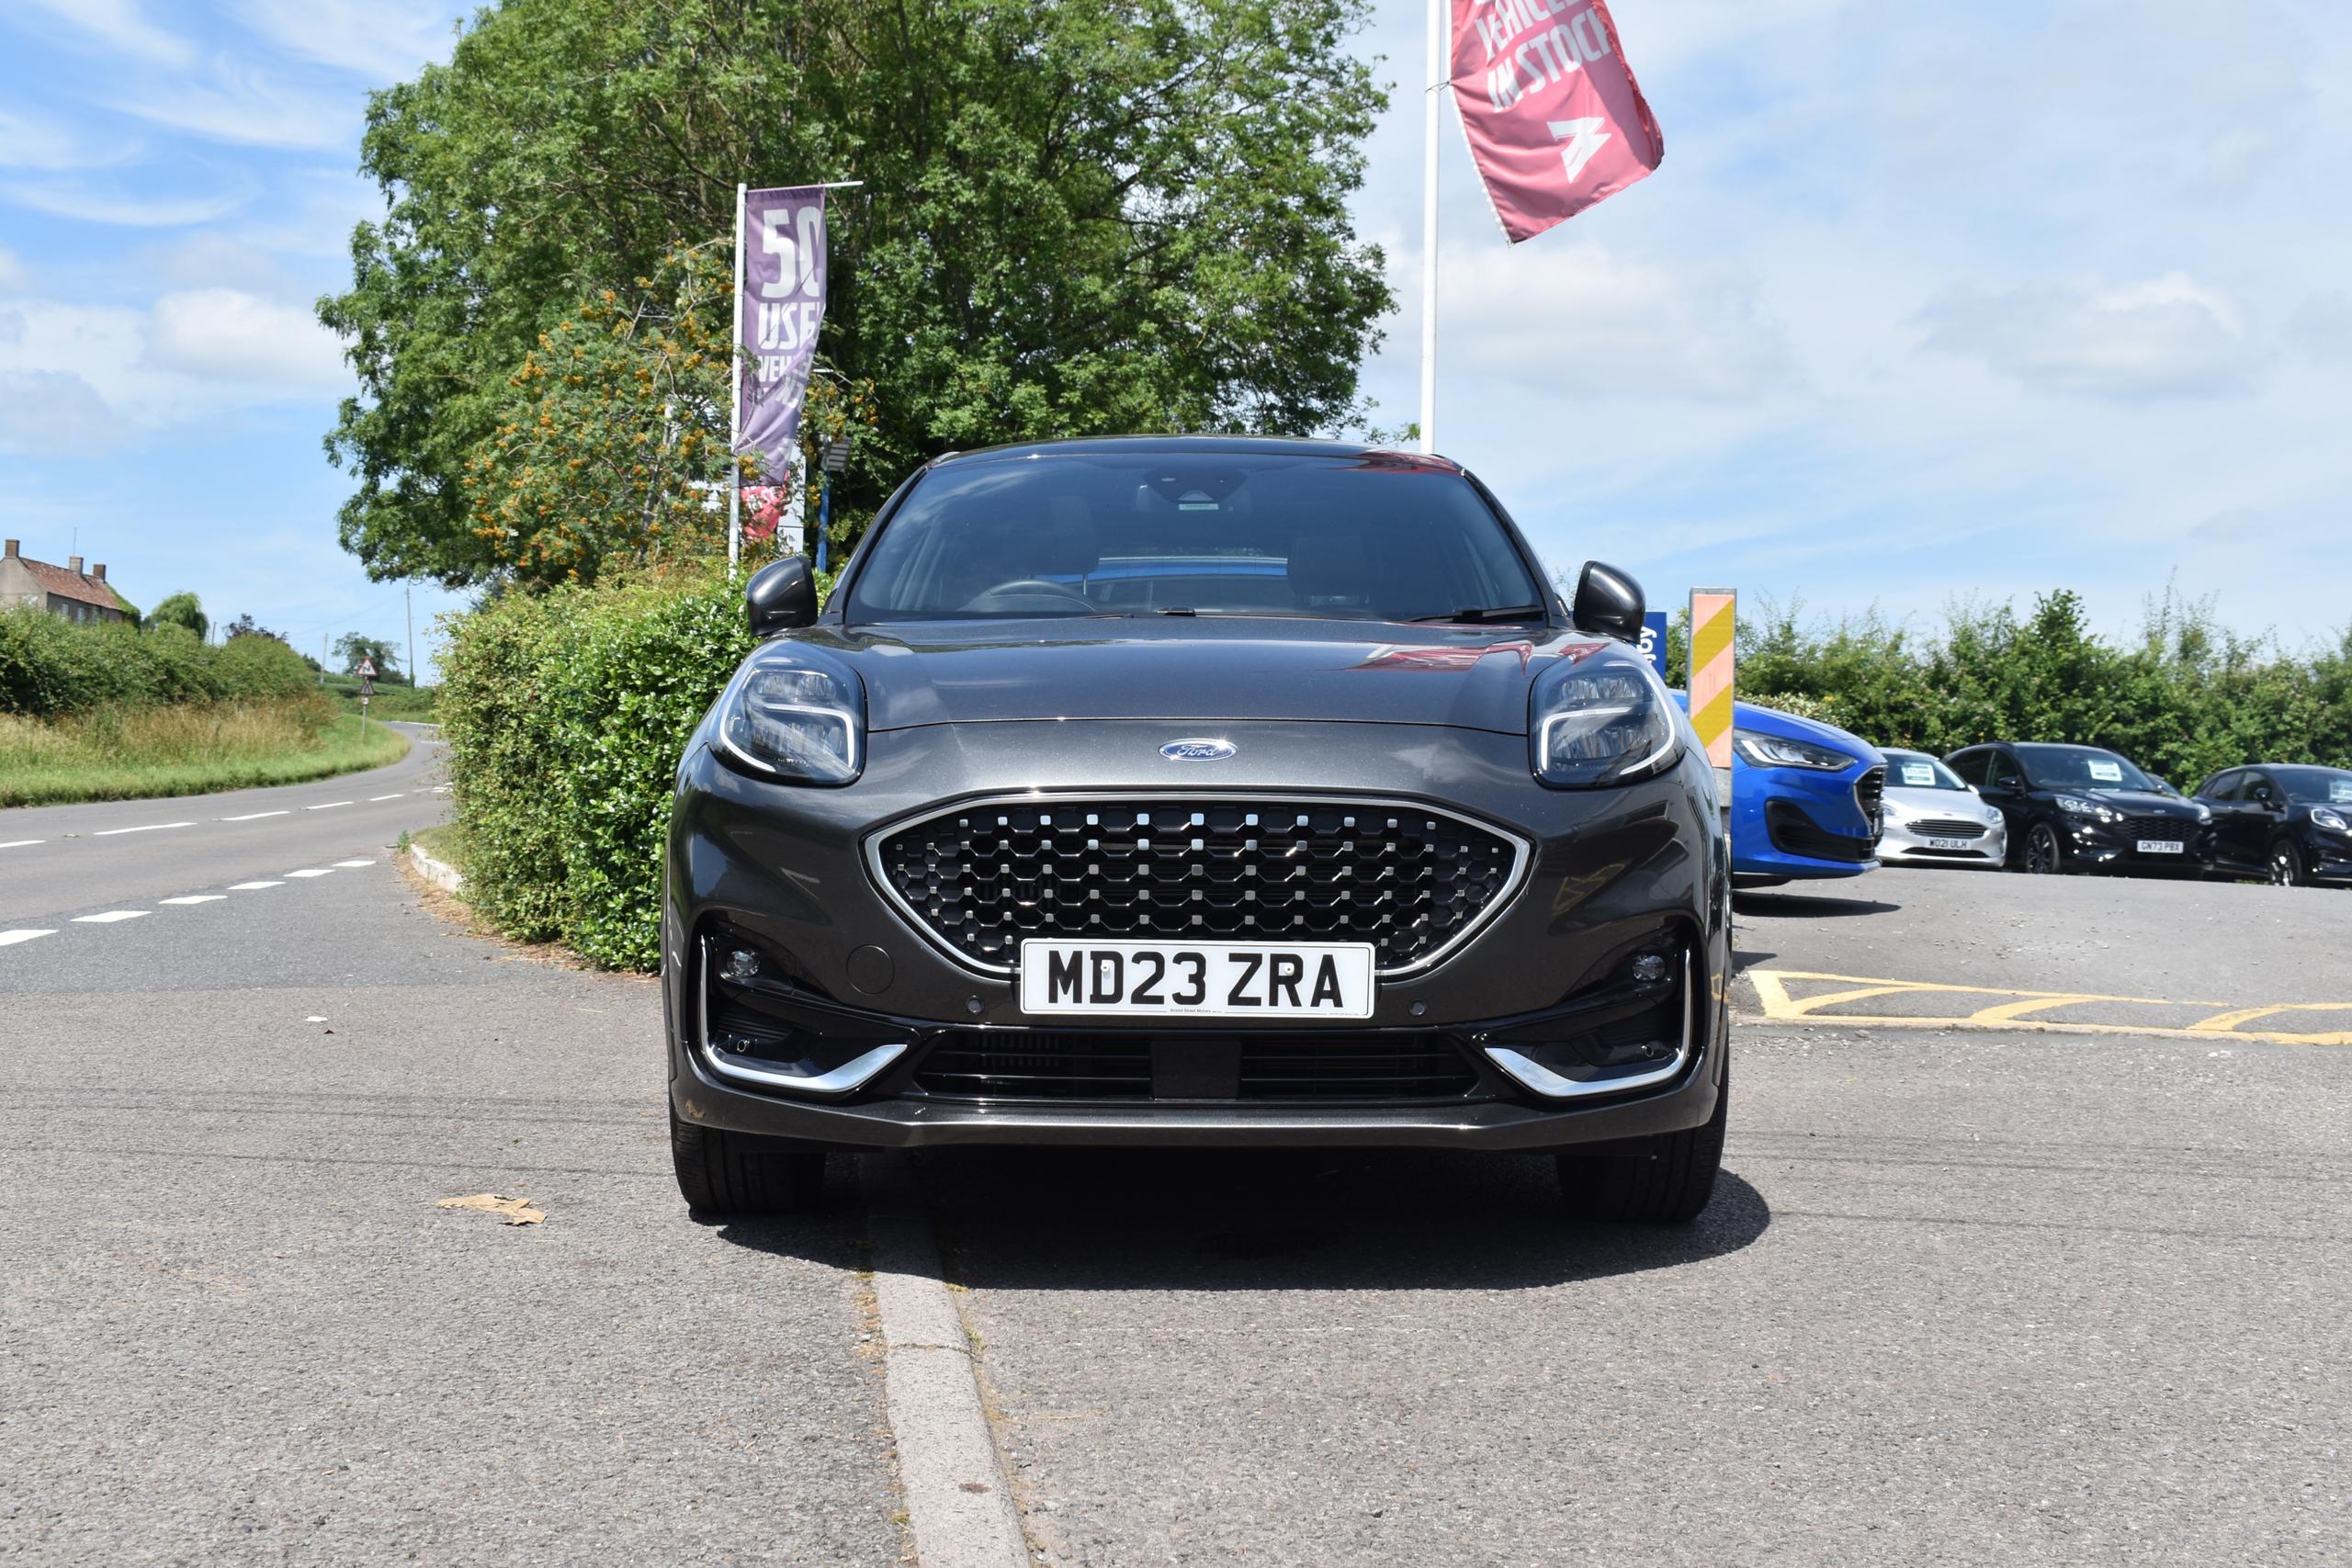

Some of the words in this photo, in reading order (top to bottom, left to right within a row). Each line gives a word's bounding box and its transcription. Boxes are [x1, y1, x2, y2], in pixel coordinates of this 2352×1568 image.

[1487, 56, 1523, 113] IN
[757, 301, 820, 350] USE
[1176, 744, 1218, 757] Ford
[1048, 950, 1206, 1006] MD23
[1227, 953, 1344, 1009] ZRA
